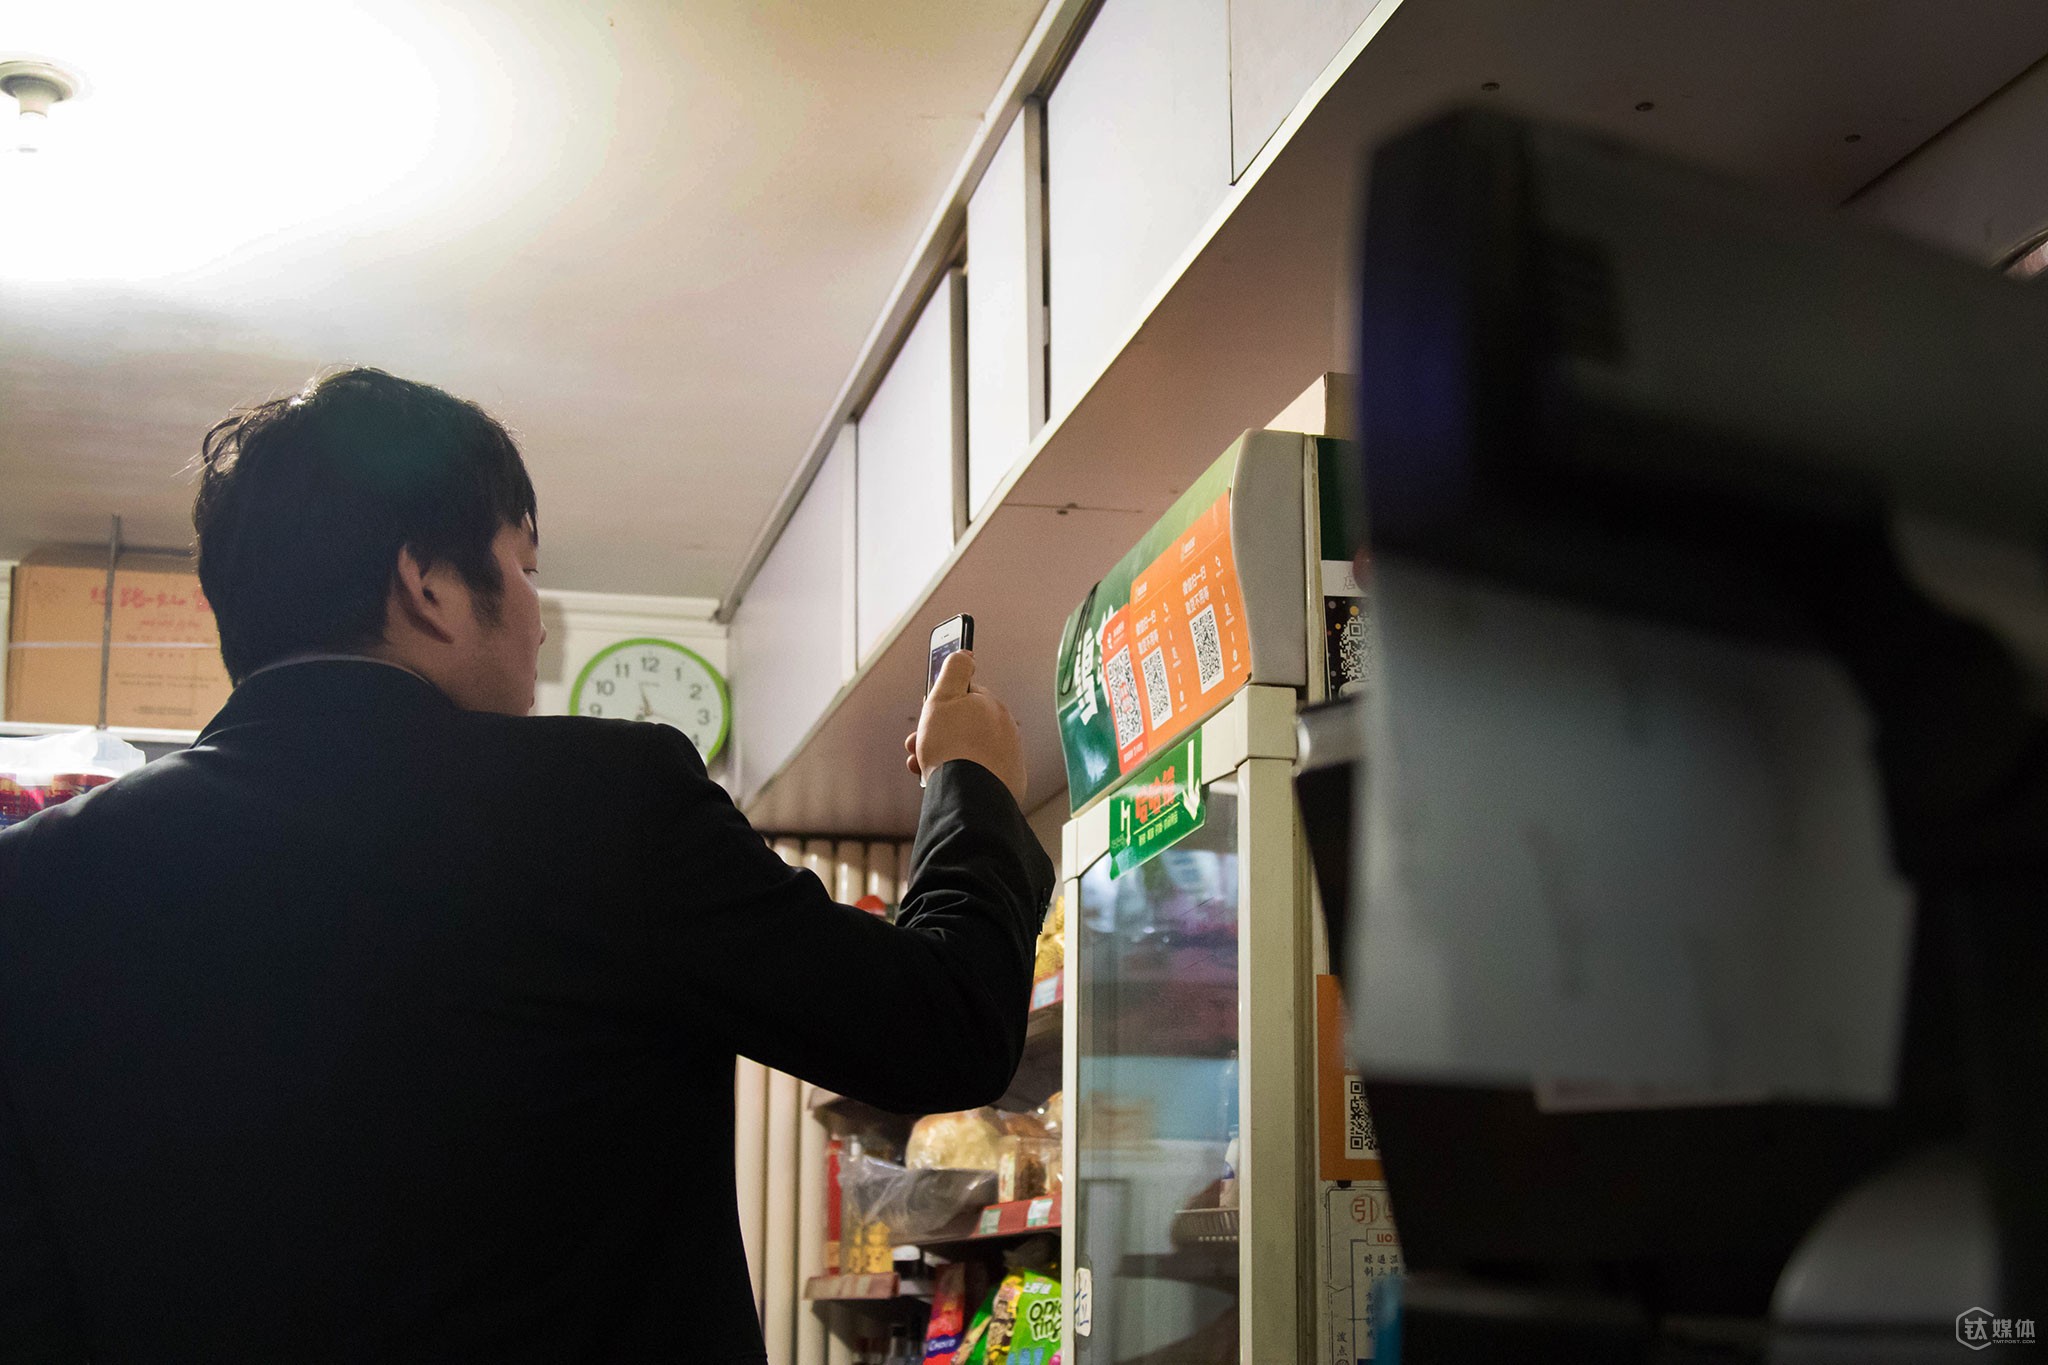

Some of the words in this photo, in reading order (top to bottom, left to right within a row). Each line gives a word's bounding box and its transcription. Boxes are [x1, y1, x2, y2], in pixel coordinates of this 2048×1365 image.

[615, 663, 630, 678] 11
[641, 656, 660, 673] 12
[675, 666, 682, 681] 1
[596, 680, 615, 696] 10
[689, 683, 702, 699] 2
[589, 703, 603, 717] 9
[697, 708, 710, 726] 3
